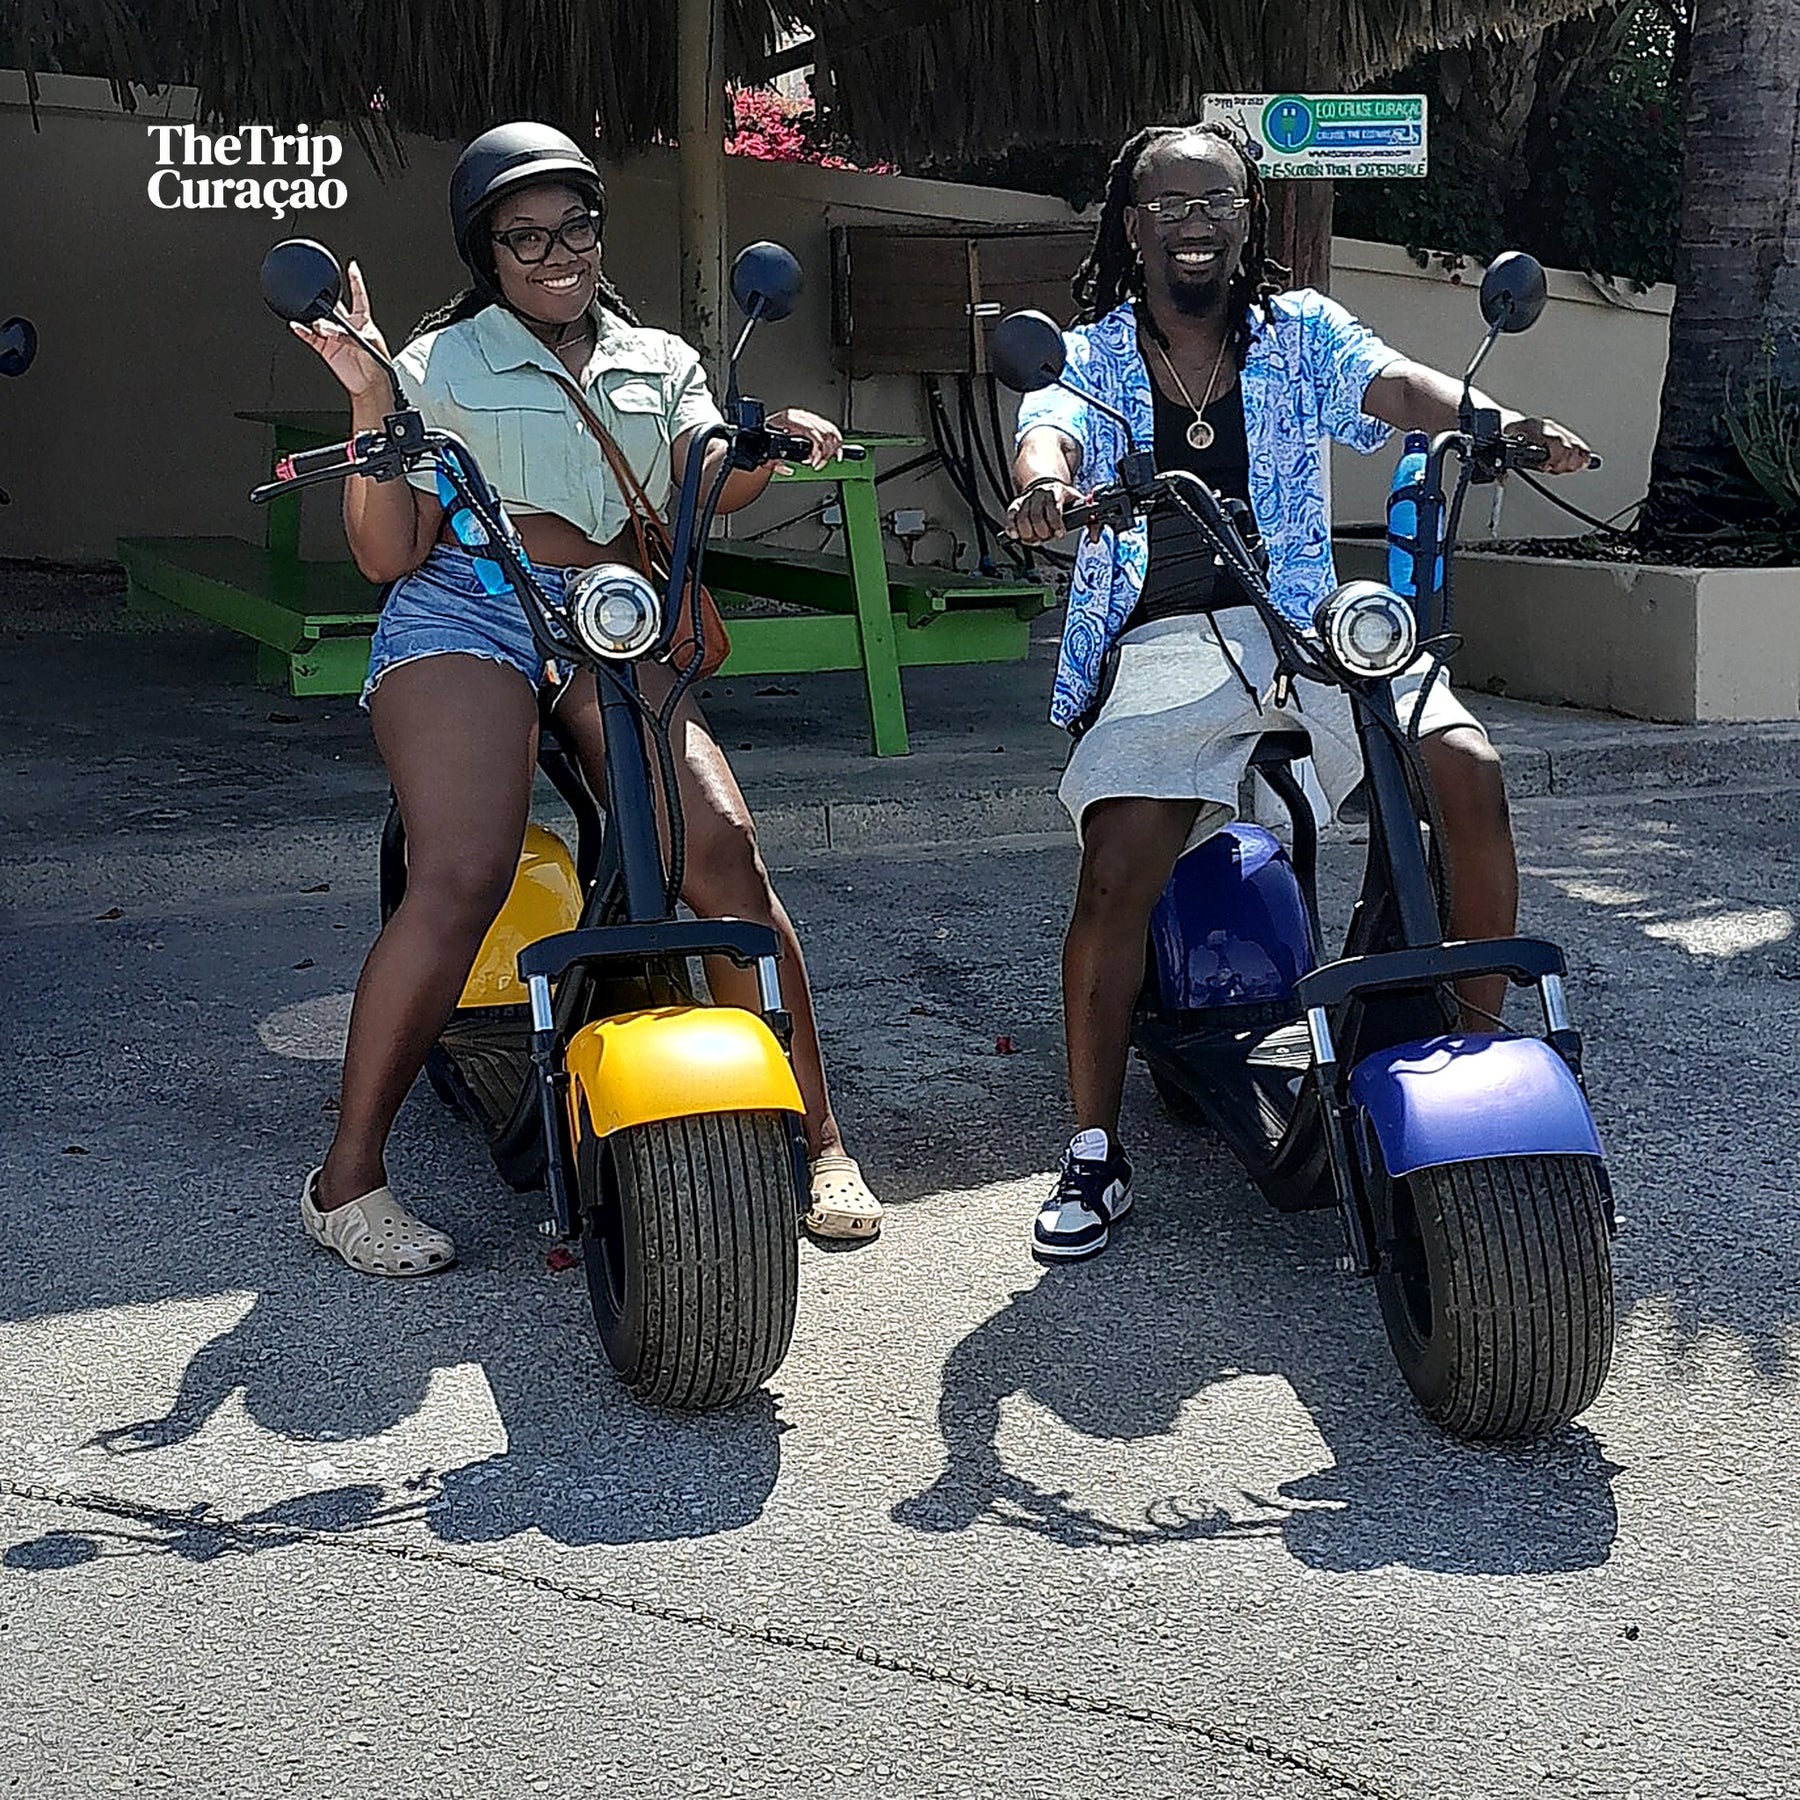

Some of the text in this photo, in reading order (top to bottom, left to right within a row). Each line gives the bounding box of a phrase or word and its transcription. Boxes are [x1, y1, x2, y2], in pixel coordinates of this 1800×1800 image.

[1316, 102, 1335, 118] ECO
[1338, 102, 1372, 117] CRUISE
[1355, 162, 1425, 177] EXPERIENCE
